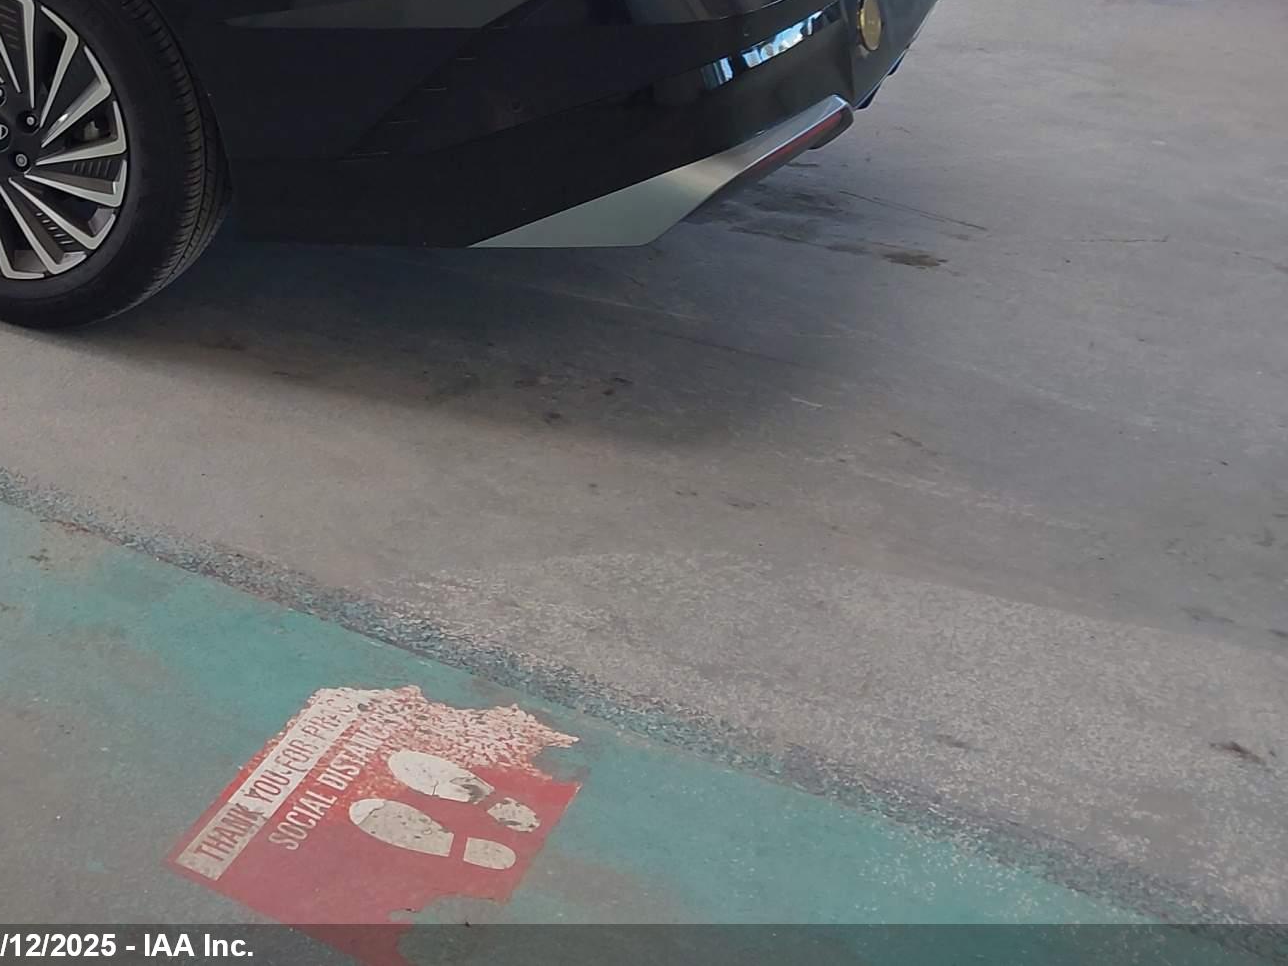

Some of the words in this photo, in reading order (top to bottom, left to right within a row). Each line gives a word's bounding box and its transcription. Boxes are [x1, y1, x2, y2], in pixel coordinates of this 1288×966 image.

[193, 802, 264, 862] THANK
[243, 769, 291, 804] YOU
[274, 738, 320, 775] FOR
[268, 790, 338, 851] SOCIAL
